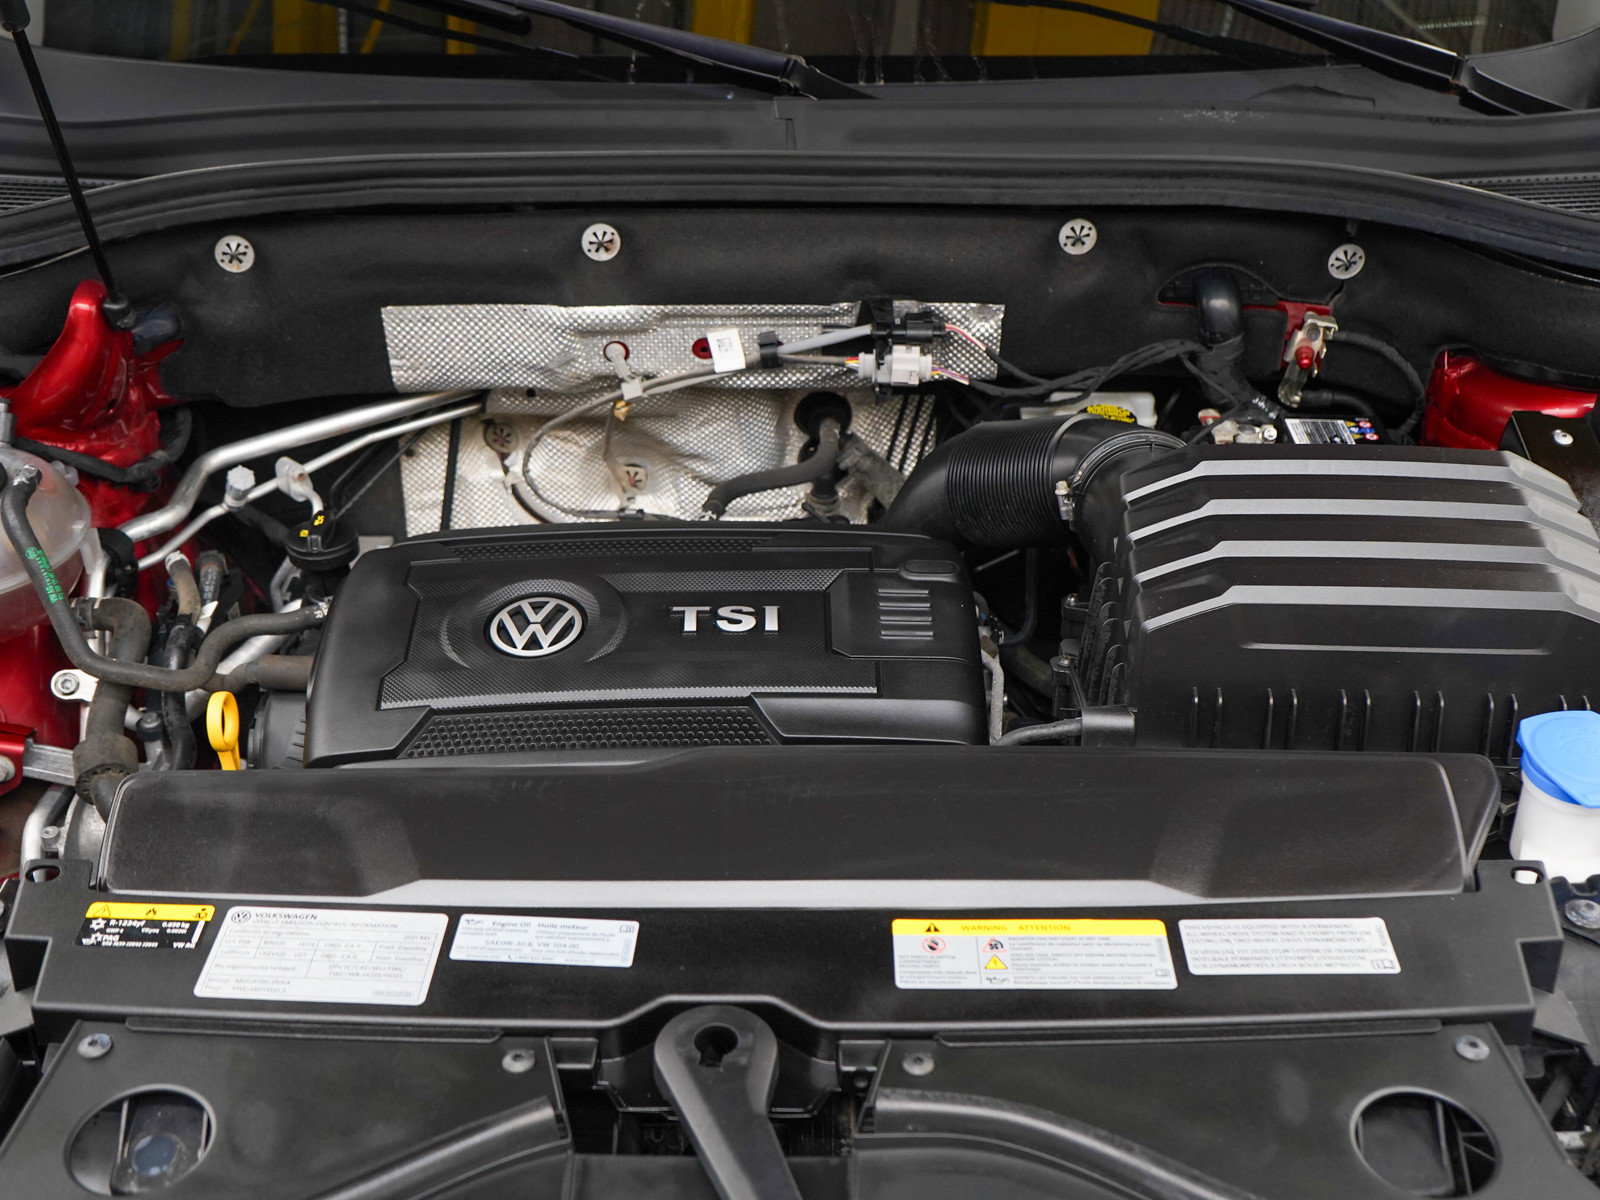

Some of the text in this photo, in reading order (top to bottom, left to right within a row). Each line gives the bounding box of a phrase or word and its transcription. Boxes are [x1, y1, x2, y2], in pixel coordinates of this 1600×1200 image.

[671, 605, 780, 634] TSI
[255, 912, 318, 920] VOLKSWAGEN
[492, 920, 518, 929] Engine
